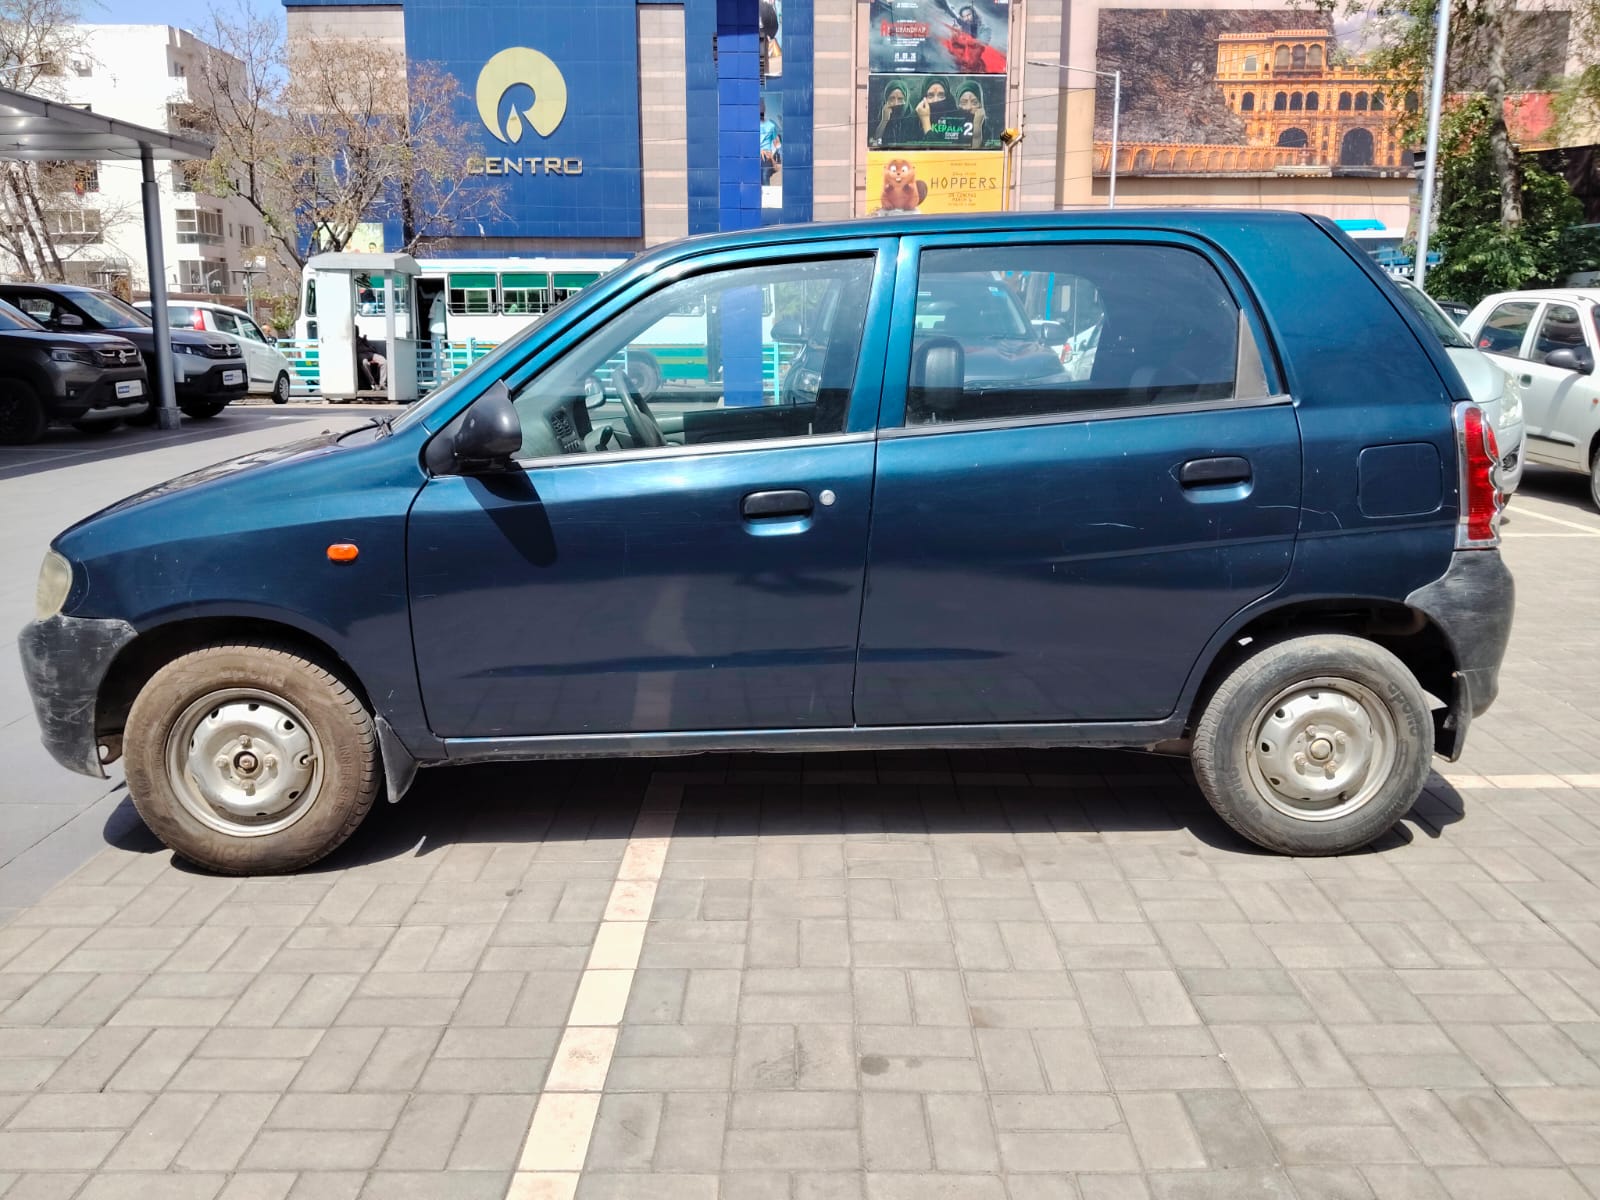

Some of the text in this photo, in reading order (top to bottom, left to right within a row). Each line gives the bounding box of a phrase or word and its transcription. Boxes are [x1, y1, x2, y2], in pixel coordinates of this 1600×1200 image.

[963, 122, 974, 136] 2
[466, 157, 583, 175] CENTRO
[930, 177, 997, 190] HOPPERS
[1388, 682, 1421, 738] apollo
